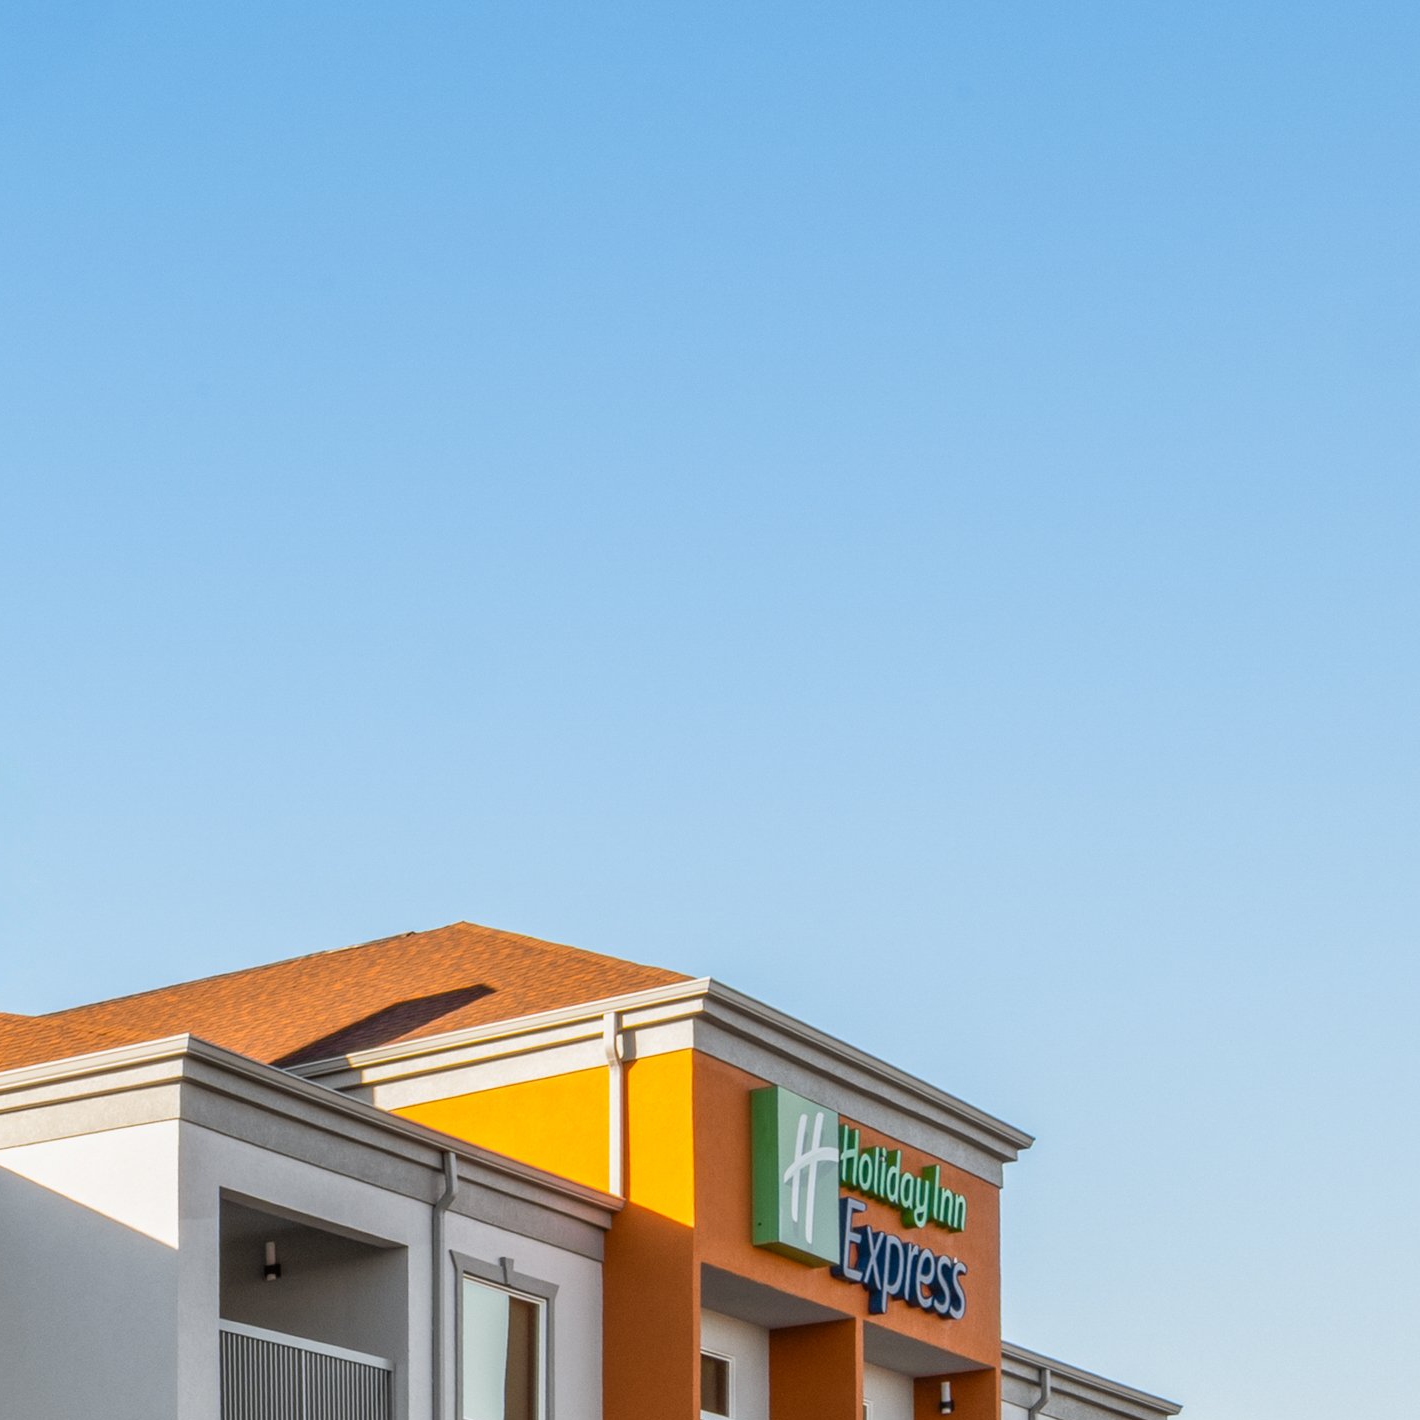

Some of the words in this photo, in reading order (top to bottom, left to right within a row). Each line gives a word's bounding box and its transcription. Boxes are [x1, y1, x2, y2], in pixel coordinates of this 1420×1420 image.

[840, 1124, 930, 1228] Holiday
[934, 1164, 967, 1232] Inn
[841, 1197, 968, 1320] Express
